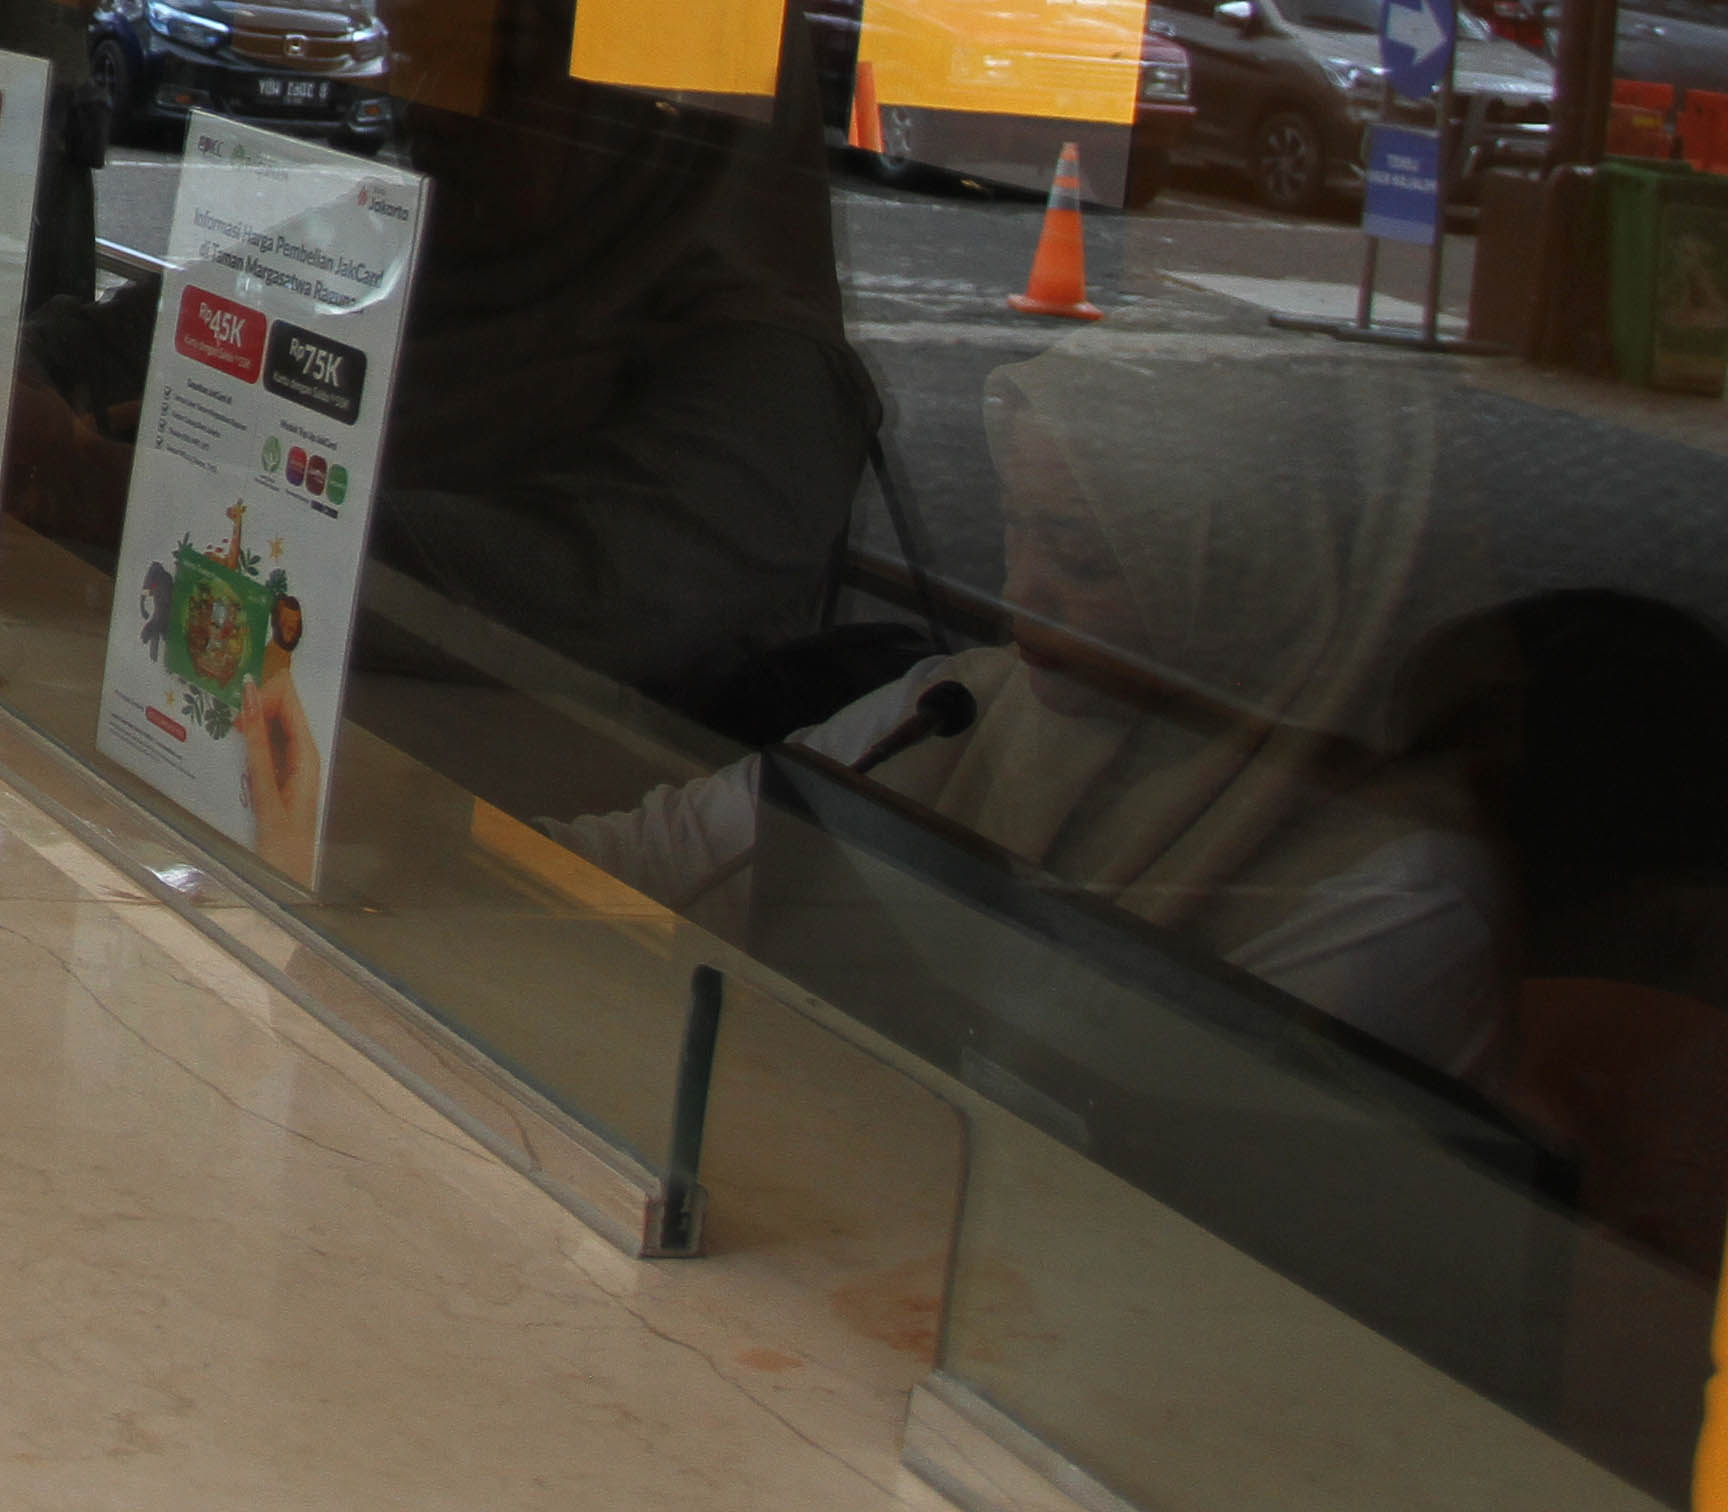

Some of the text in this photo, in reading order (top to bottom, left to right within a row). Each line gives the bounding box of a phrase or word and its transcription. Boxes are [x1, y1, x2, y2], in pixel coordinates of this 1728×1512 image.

[194, 208, 242, 242] Informasi
[243, 224, 274, 256] Harga
[275, 235, 334, 273] Pembelian
[211, 246, 244, 273] Taman
[245, 255, 312, 299] Margasatwa
